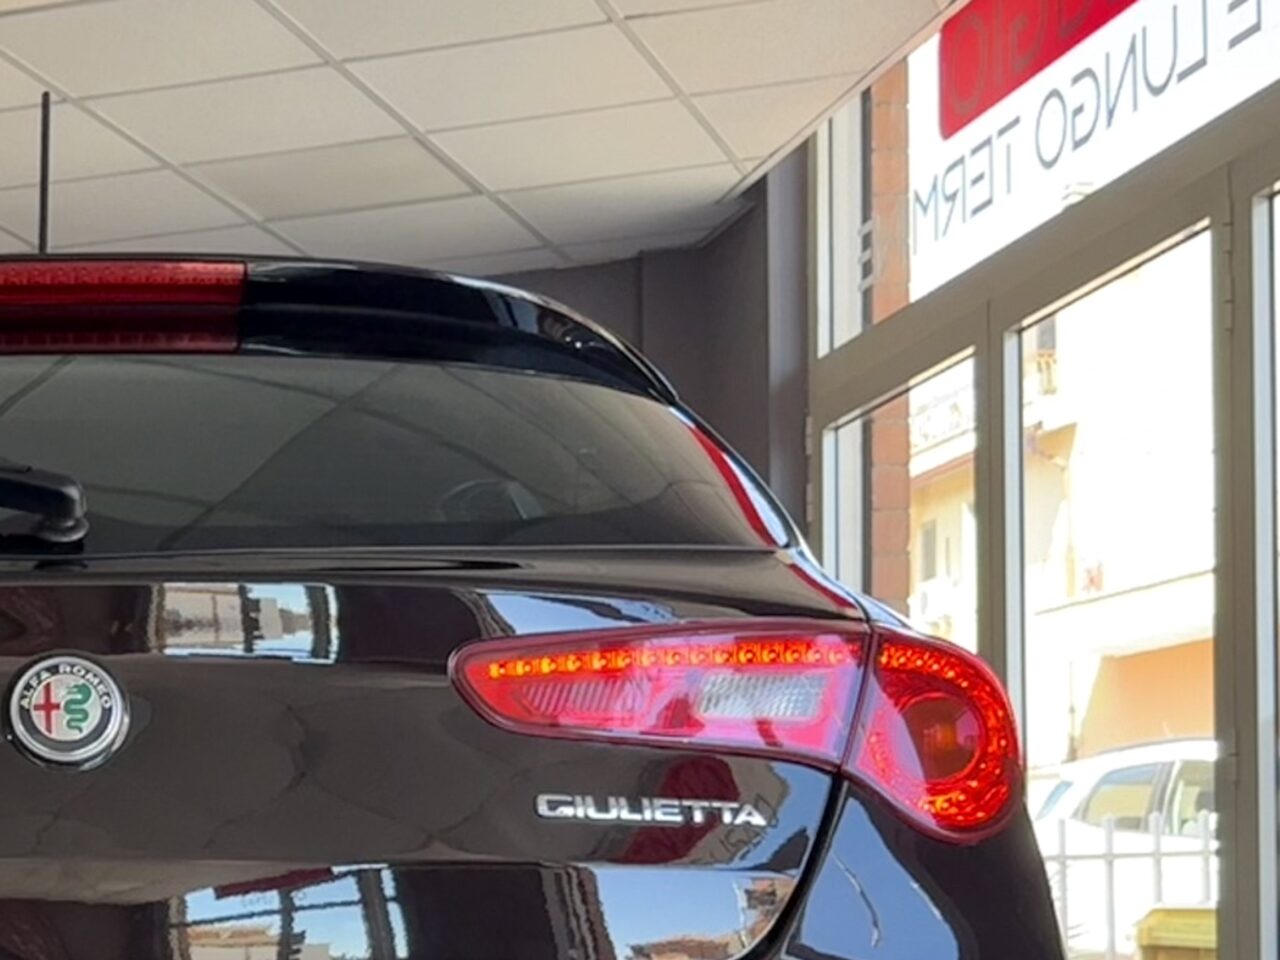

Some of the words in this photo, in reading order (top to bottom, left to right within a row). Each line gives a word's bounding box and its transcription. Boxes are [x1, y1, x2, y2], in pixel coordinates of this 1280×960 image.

[20, 669, 52, 710] ALFA
[58, 663, 113, 709] ROMEO
[536, 794, 767, 827] GIULIETTA
